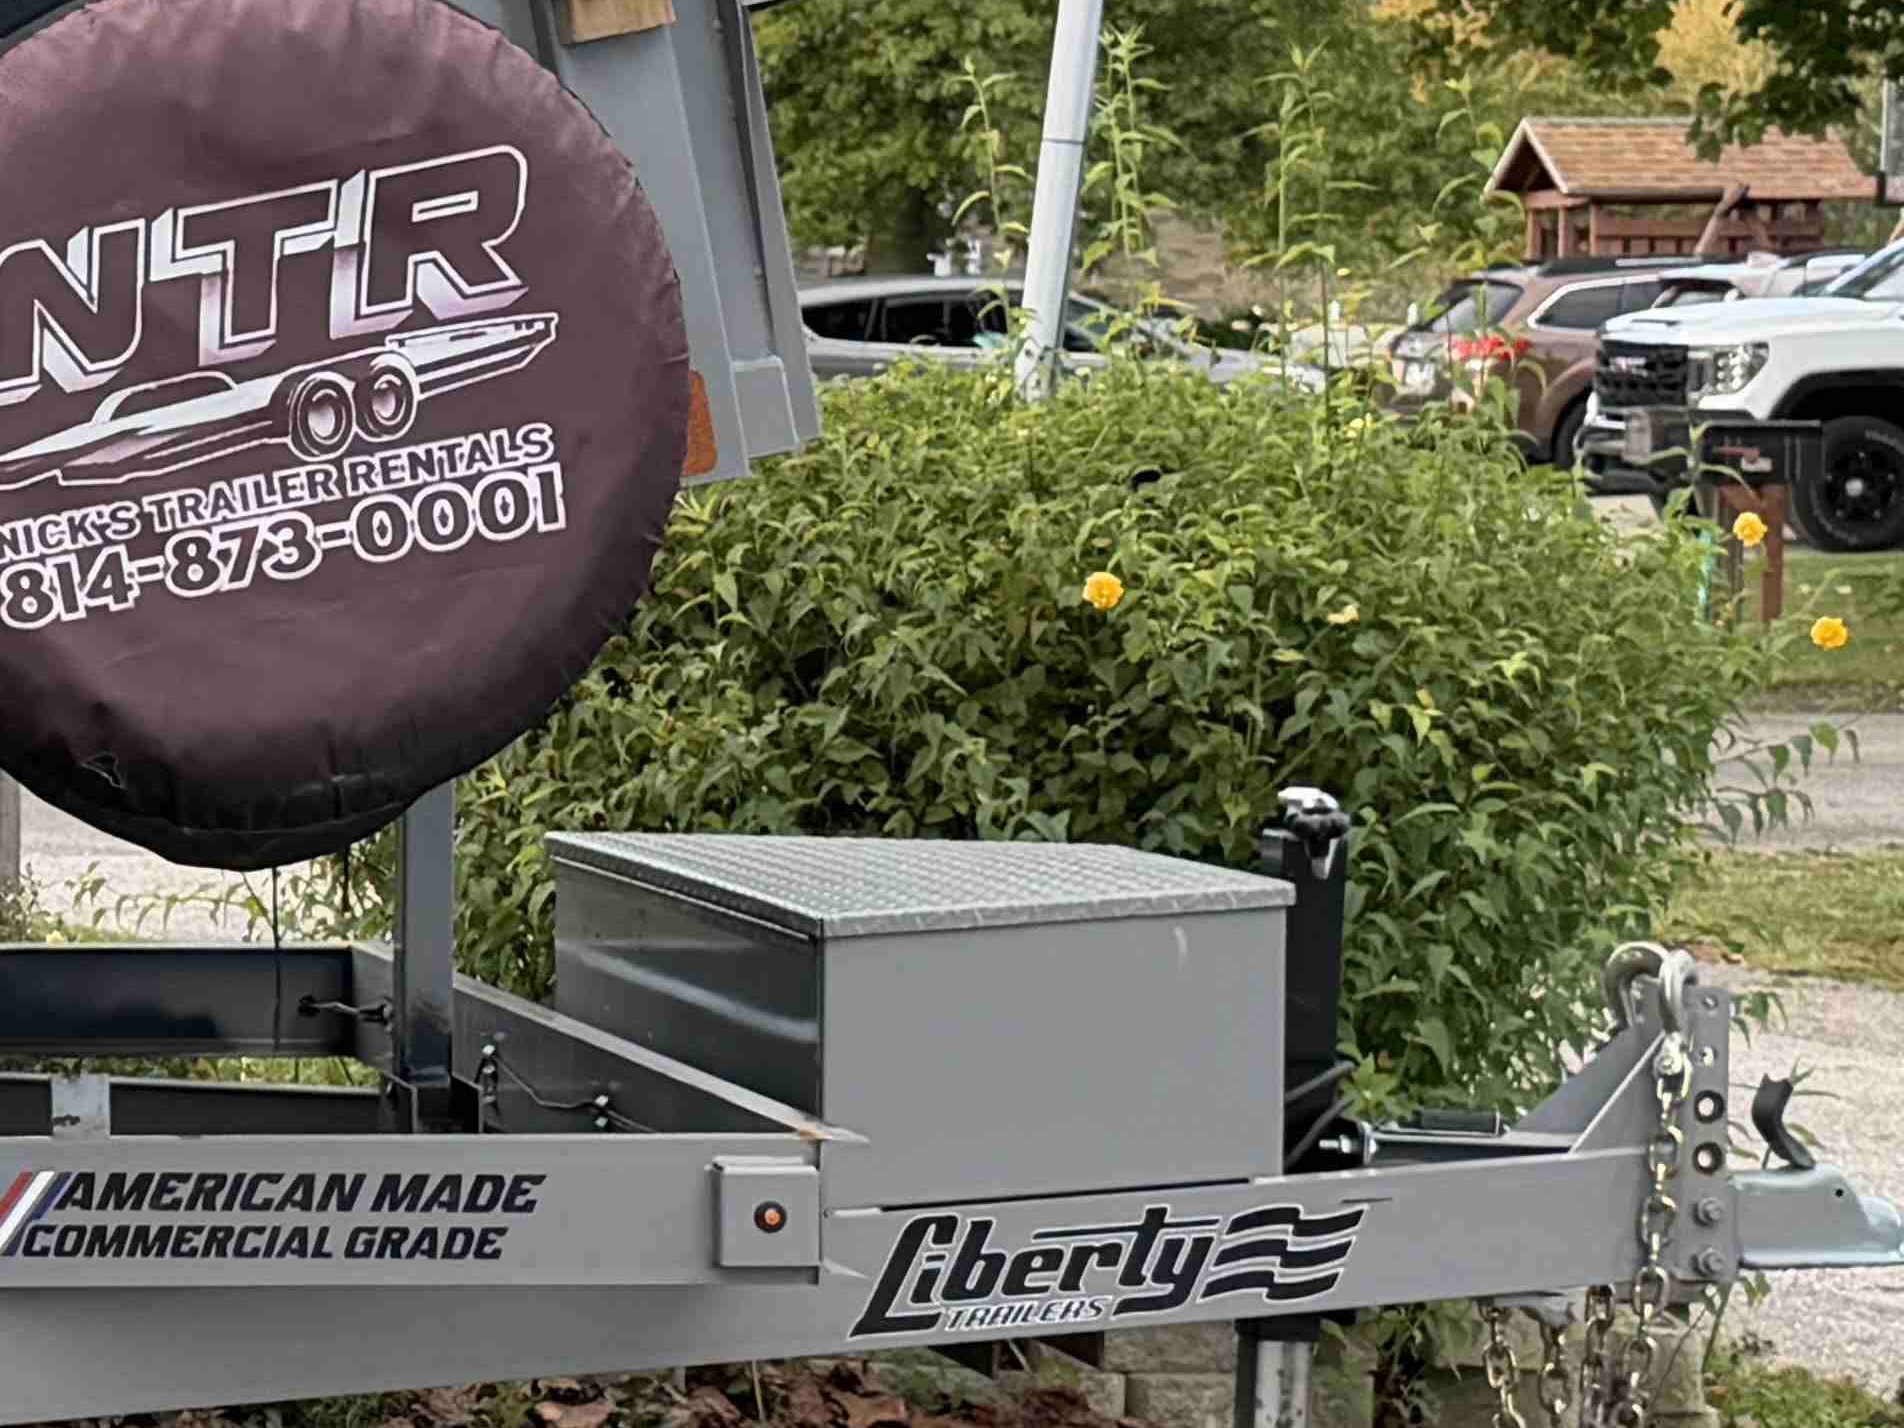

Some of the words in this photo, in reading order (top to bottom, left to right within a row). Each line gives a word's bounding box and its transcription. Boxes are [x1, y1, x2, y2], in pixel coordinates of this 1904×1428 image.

[145, 461, 338, 529] TRAILER
[344, 422, 554, 496] RENTALS
[0, 466, 567, 629] 814-873-0001
[52, 1171, 365, 1214] AMERICAN
[367, 1172, 547, 1215] MADE
[21, 1224, 334, 1262] COMMERCIAL
[341, 1225, 510, 1262] GRADE
[847, 1203, 1222, 1341] Liberty
[944, 1294, 1114, 1333] TRAILERS
